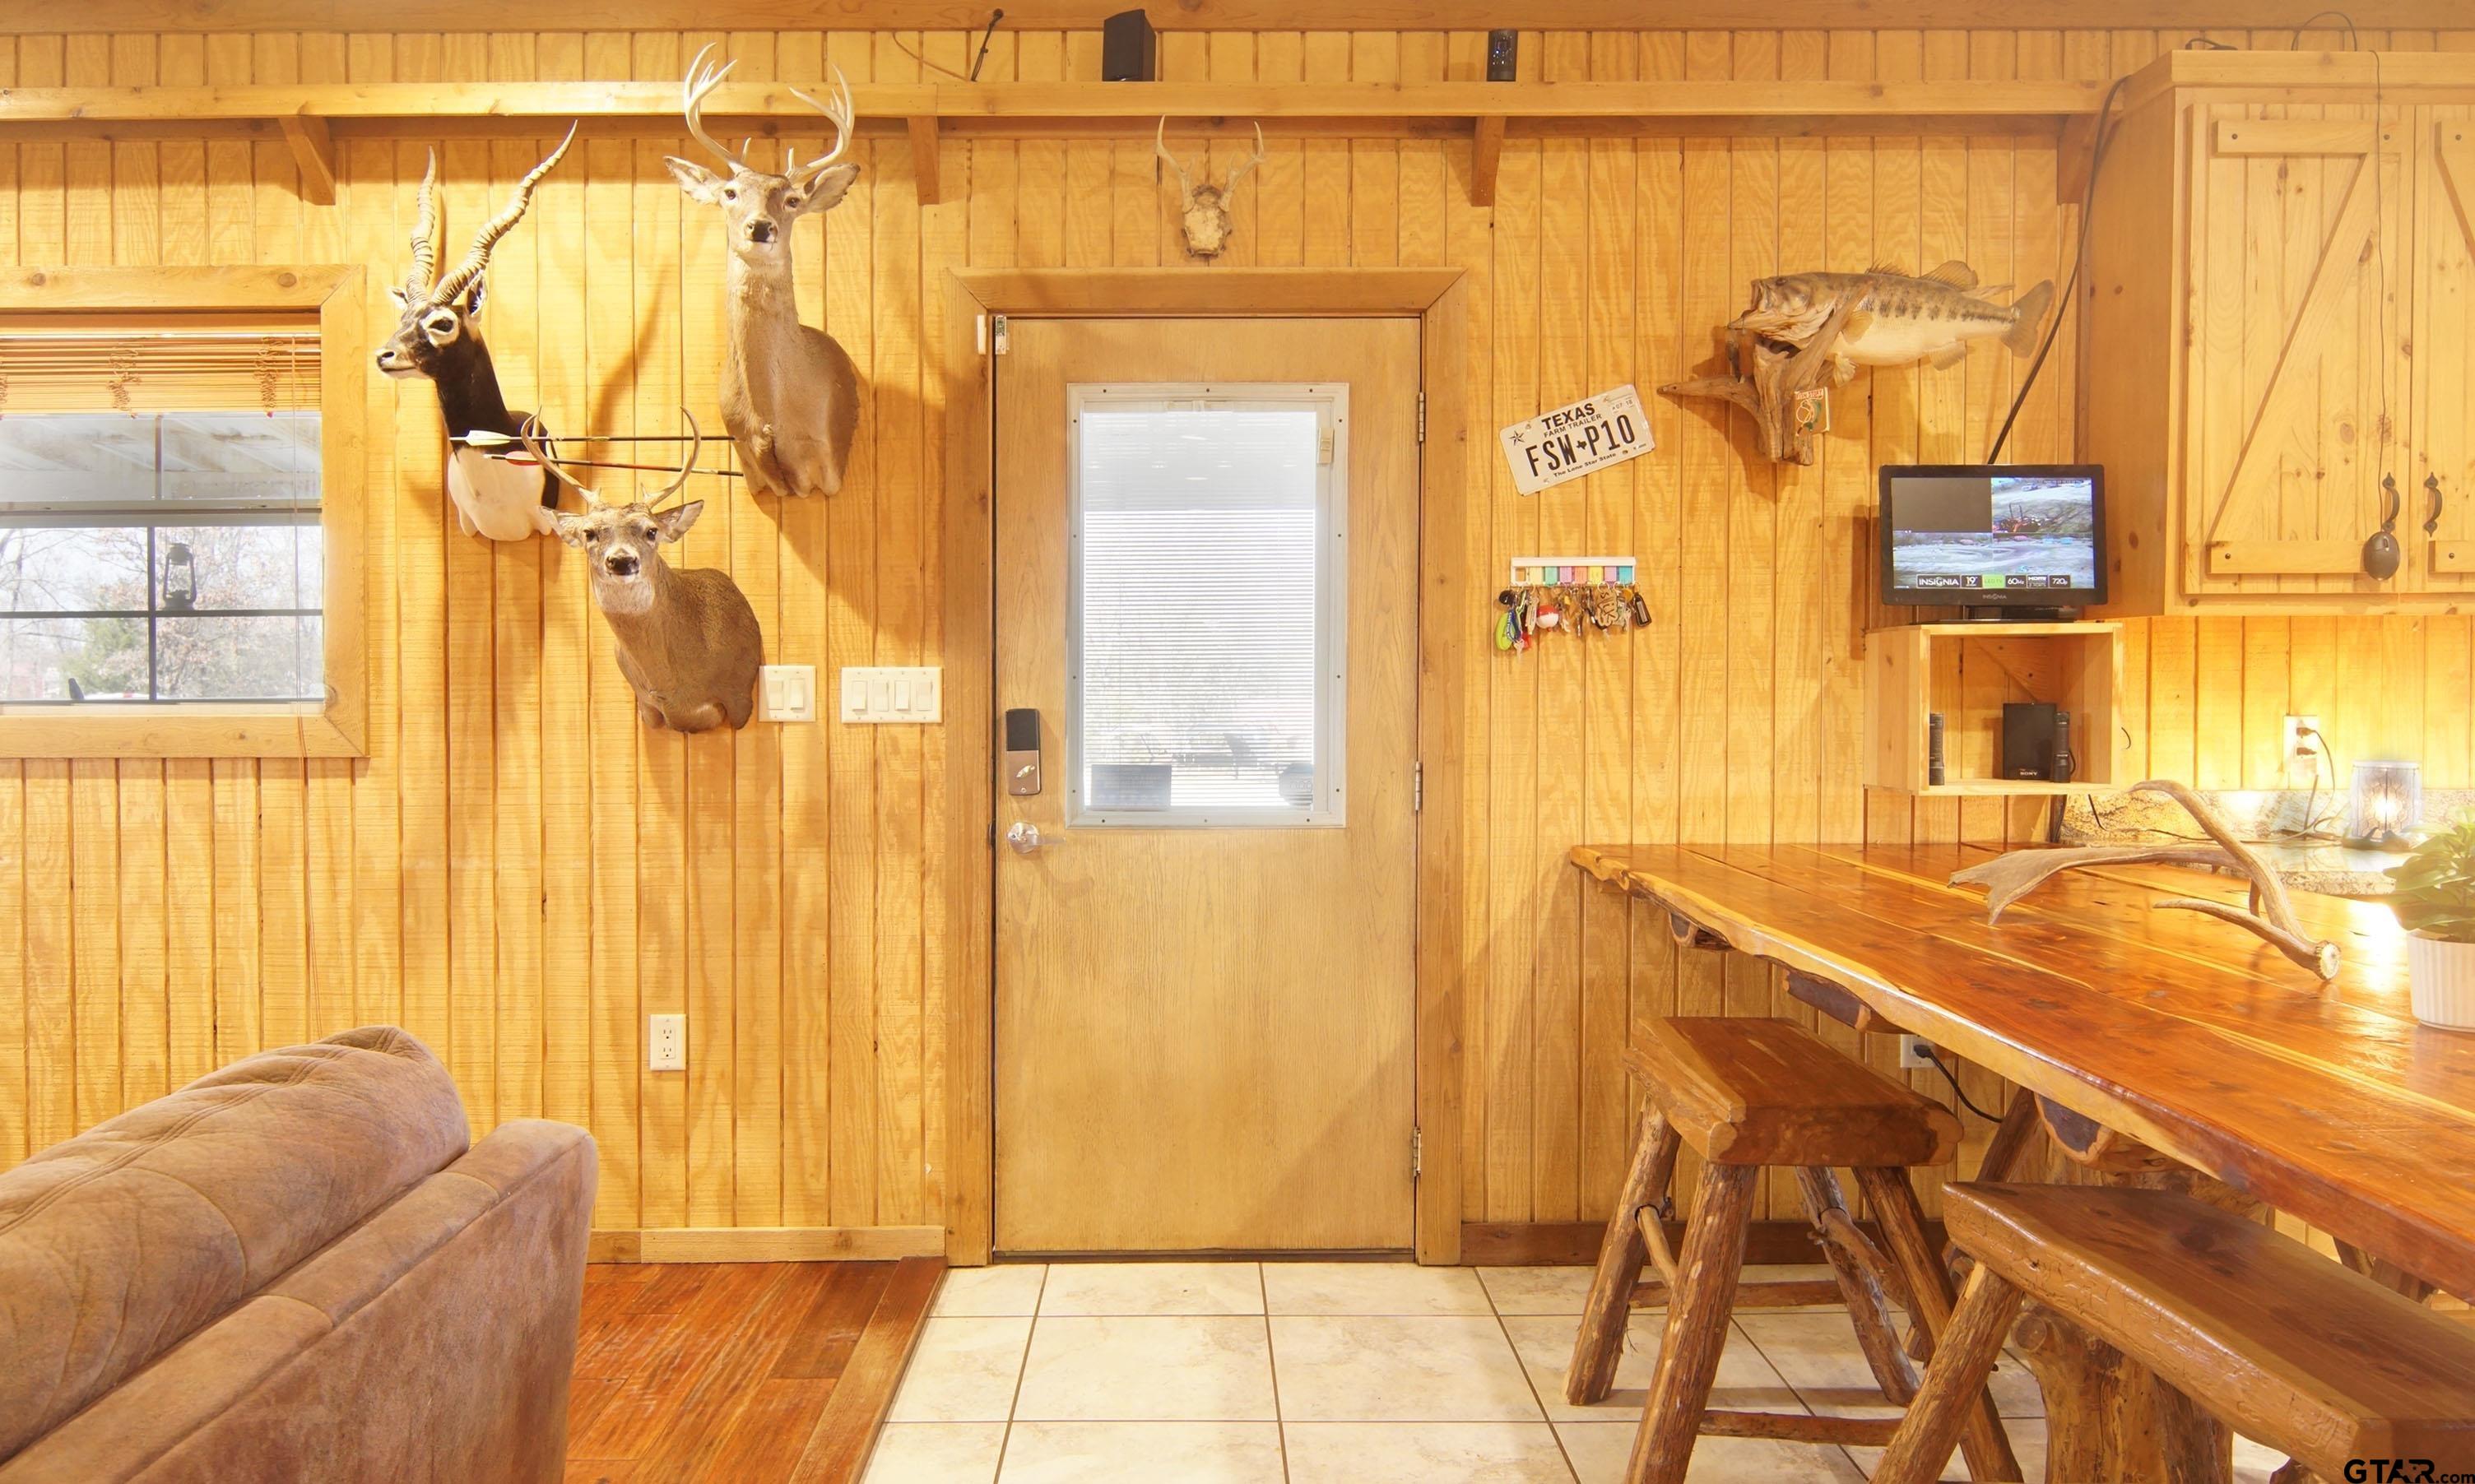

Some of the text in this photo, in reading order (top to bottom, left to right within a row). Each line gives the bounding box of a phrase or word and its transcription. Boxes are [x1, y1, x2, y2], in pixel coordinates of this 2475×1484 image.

[1541, 403, 1595, 430] TEXAS
[1544, 414, 1602, 438] FARM TRAILER
[1567, 465, 1583, 473] Lone
[1919, 577, 1959, 587] INSIGNIA
[2052, 577, 2068, 586] 720p
